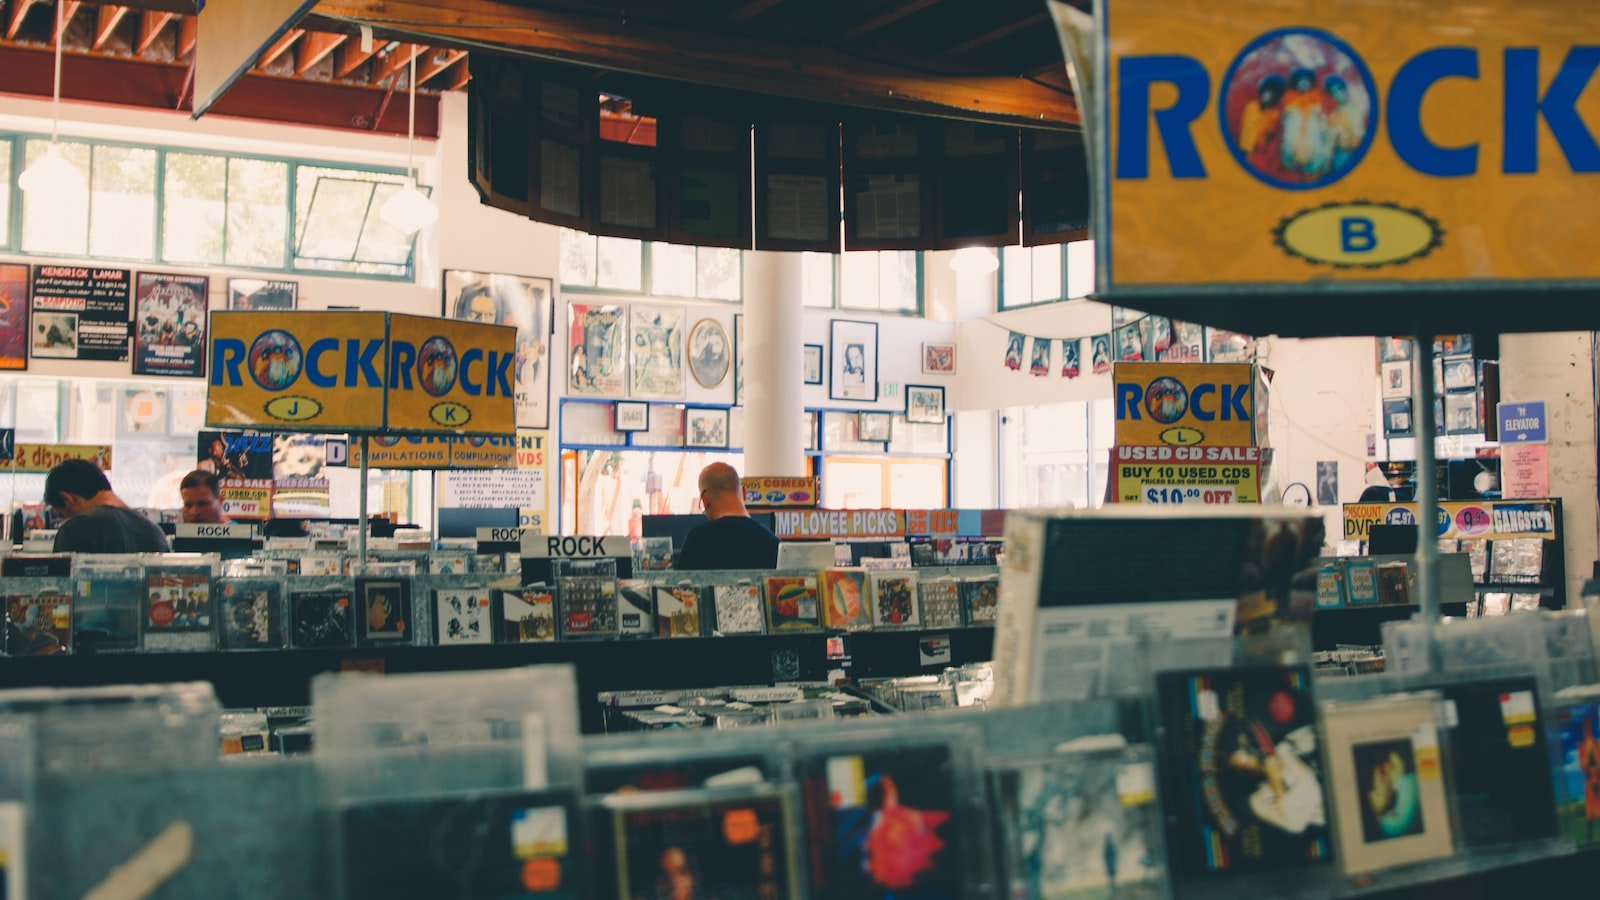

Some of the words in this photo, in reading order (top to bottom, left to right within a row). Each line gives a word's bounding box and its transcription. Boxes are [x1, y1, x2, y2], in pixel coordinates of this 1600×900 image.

[1116, 26, 1600, 191] ROCK
[1340, 217, 1378, 253] B
[41, 266, 88, 278] KENDRICK
[93, 269, 122, 280] LAMAR
[35, 278, 84, 287] performance
[96, 281, 127, 289] signing
[211, 329, 384, 391] ROCK
[390, 336, 514, 398] ROCK
[883, 383, 898, 397] EXIT
[1116, 376, 1250, 425] ROCK
[288, 401, 299, 417] J
[444, 407, 456, 421] K
[1505, 417, 1540, 432] ELEVATOR
[1177, 431, 1187, 443] L
[354, 451, 444, 462] CMPILATIONS
[454, 451, 512, 463] COMPILATIONS
[1118, 446, 1172, 460] USED
[1175, 446, 1204, 460] CD
[1206, 446, 1258, 461] SALE
[1122, 467, 1152, 479] BUY
[1157, 467, 1174, 479] 10
[1178, 467, 1217, 479] USED
[1221, 467, 1251, 479] CDS
[245, 480, 272, 488] SALE
[745, 481, 761, 489] VDS
[763, 479, 814, 488] COMEDY
[1203, 490, 1233, 504] OFF
[1345, 506, 1382, 518] DISCOUNT
[775, 511, 848, 536] MPLOYEE
[853, 511, 897, 534] PICKS
[930, 509, 960, 532] ROCK
[1493, 508, 1553, 534] GANGSTER
[197, 526, 231, 537] ROCK
[492, 529, 526, 541] ROCK
[547, 536, 607, 556] ROCK
